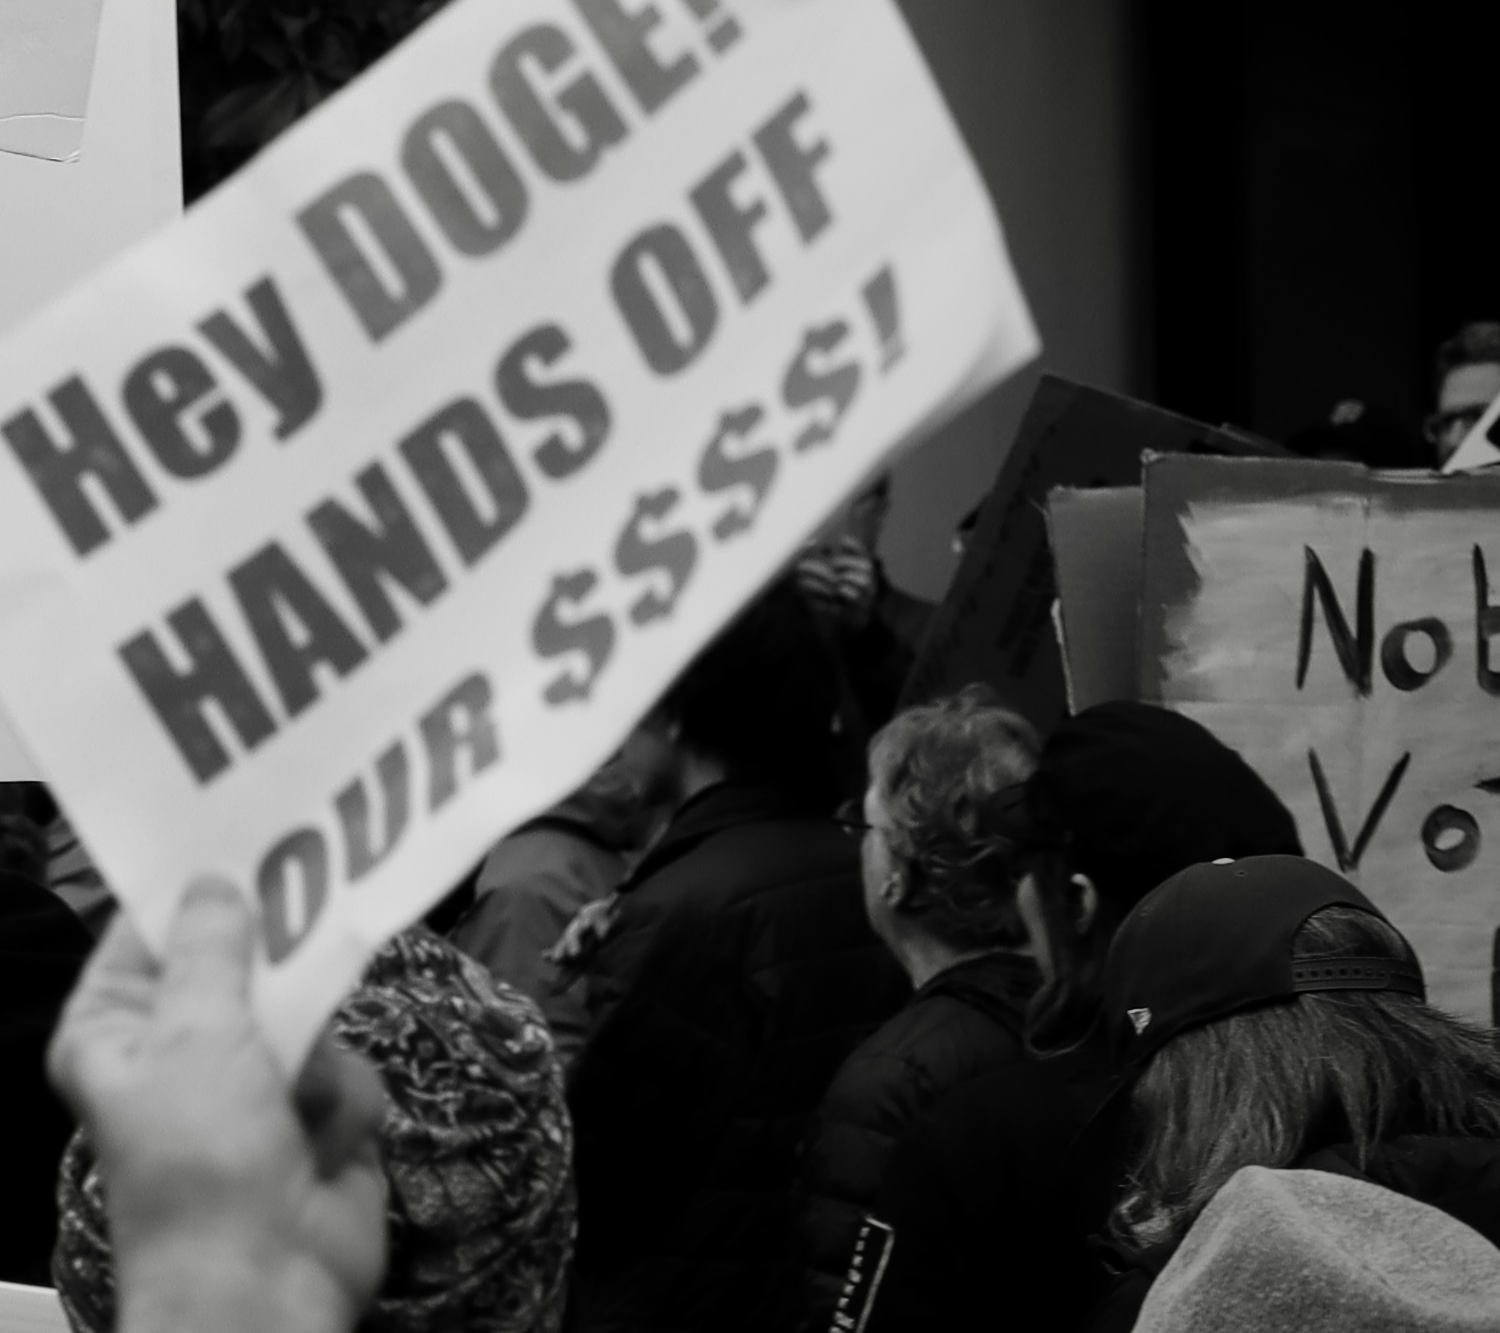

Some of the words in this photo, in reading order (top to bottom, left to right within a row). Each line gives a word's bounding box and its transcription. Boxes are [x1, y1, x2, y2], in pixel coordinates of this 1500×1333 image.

[0, 274, 325, 559] Hey
[115, 323, 615, 788] HANDS
[607, 88, 835, 376] OFF
[250, 671, 502, 967] OUR
[1307, 746, 1500, 874] Vo
